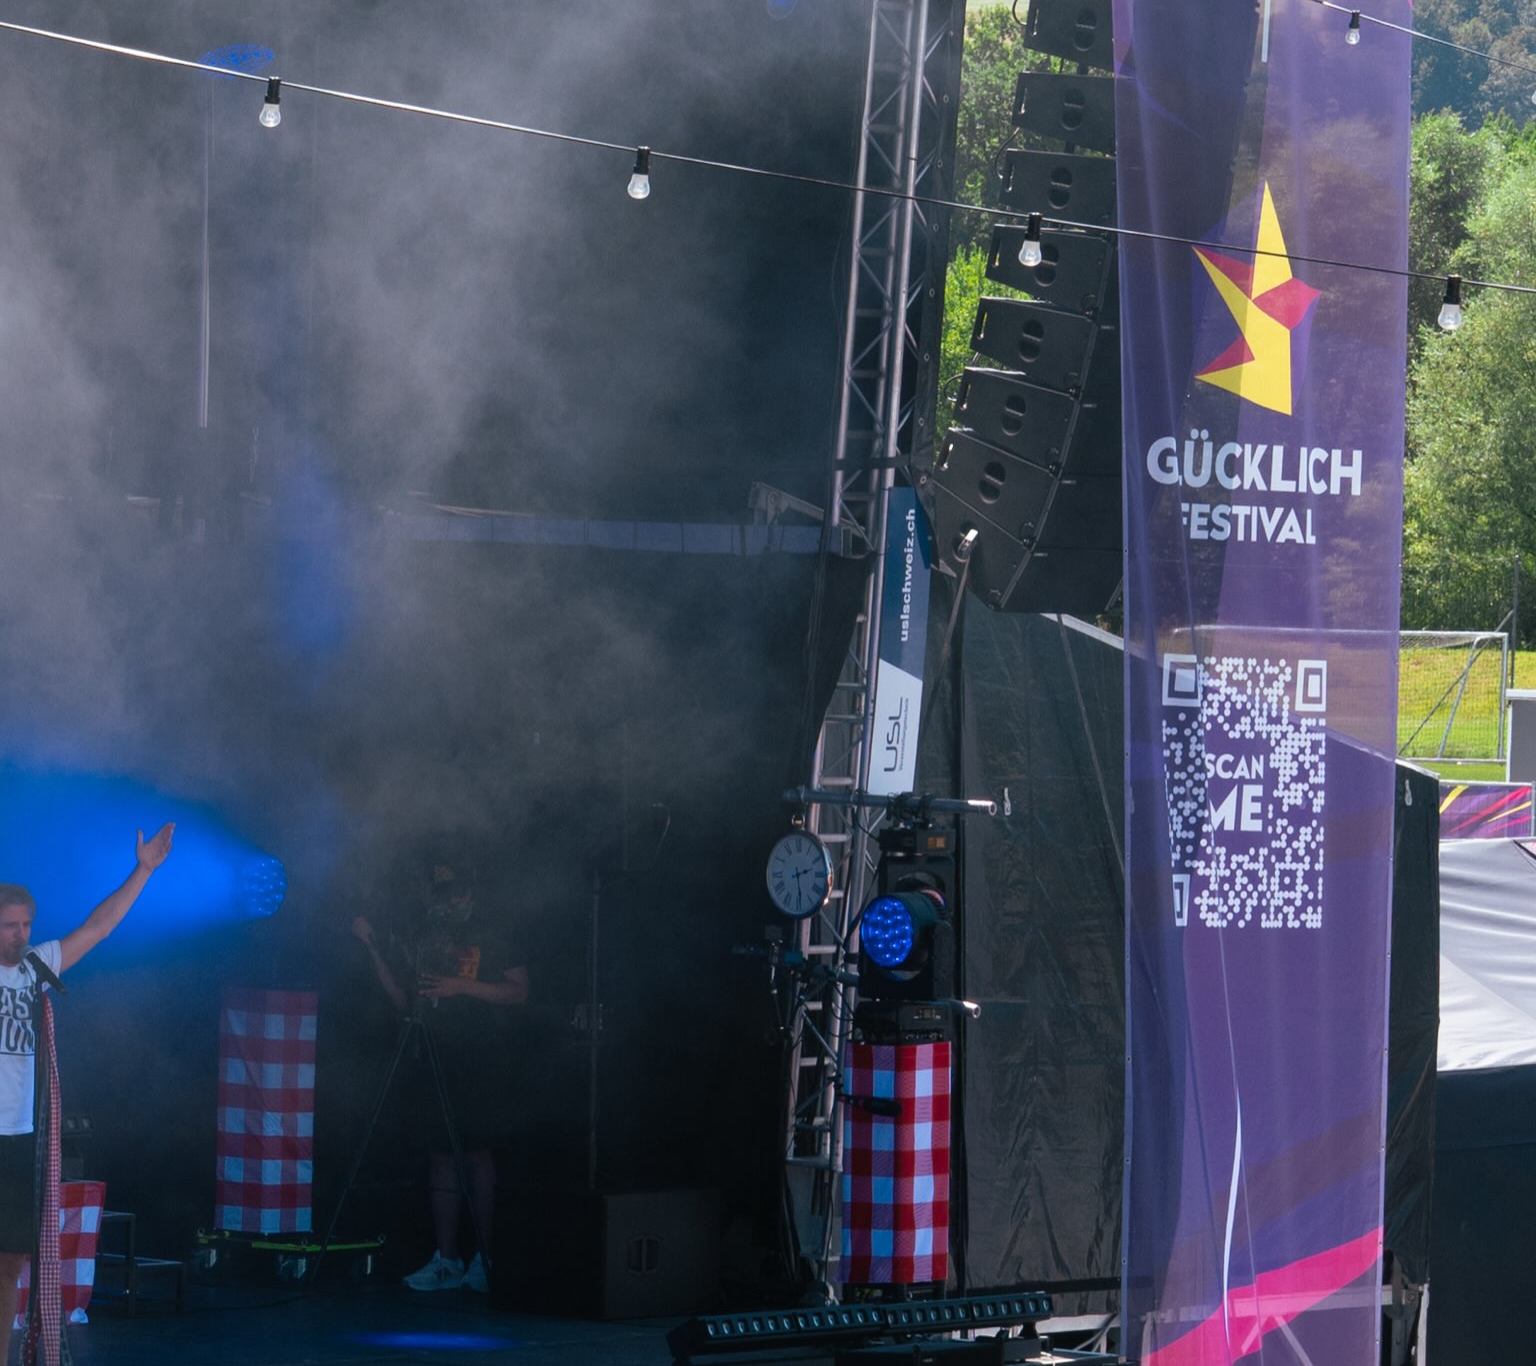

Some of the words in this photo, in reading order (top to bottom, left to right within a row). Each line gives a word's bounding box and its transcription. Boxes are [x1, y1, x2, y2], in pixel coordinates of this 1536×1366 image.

[1146, 428, 1363, 496] GÜCKLICH
[1181, 502, 1317, 545] FESTIVAL
[900, 508, 916, 642] uslschweiz.ch
[883, 696, 904, 773] USL
[1205, 753, 1264, 779] SCAN
[1210, 784, 1263, 831] ME
